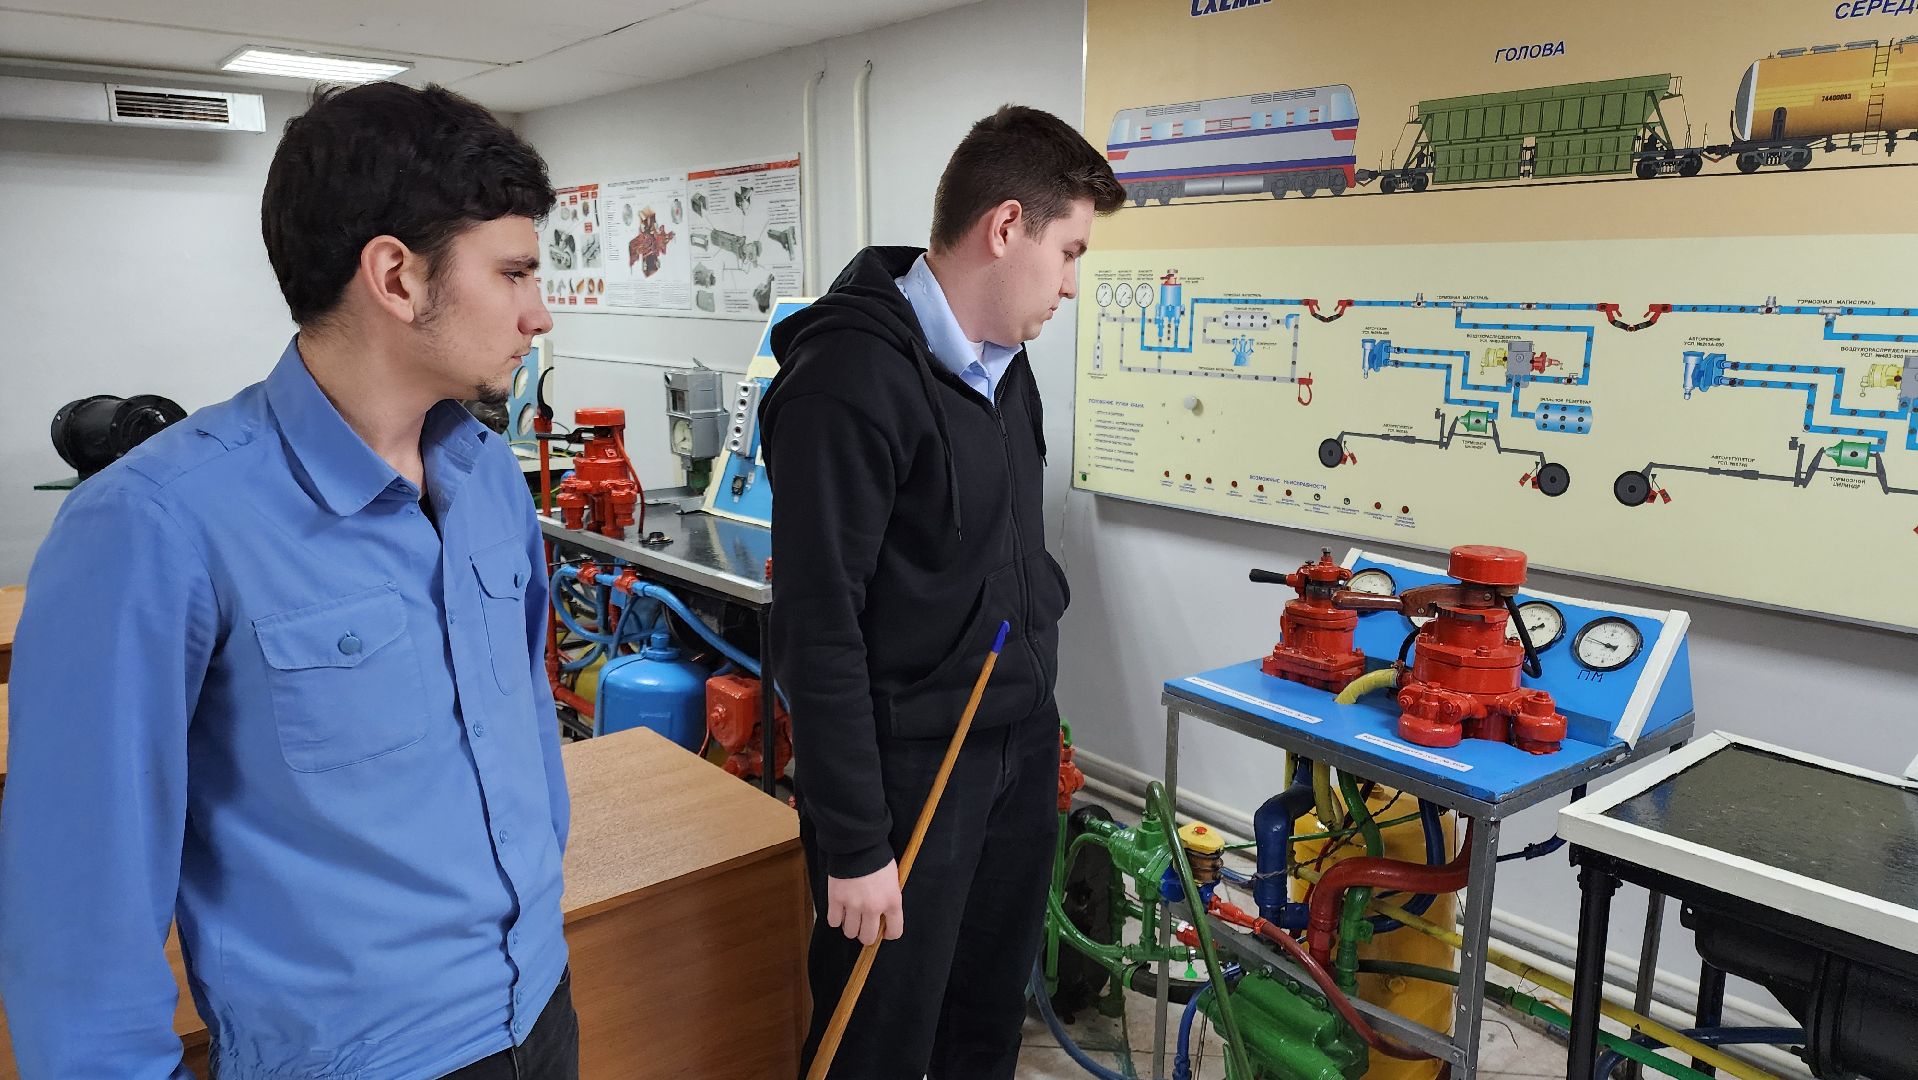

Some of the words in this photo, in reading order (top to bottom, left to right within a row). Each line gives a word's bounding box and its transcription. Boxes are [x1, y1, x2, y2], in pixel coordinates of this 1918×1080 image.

[1835, 0, 1918, 20] СЕРЕД
[1494, 40, 1565, 64] ГОЛОВА
[1840, 346, 1918, 354] ВОЗДУХОРАСПРЕДЕЛИТЕ
[1577, 669, 1604, 683] ПМ
